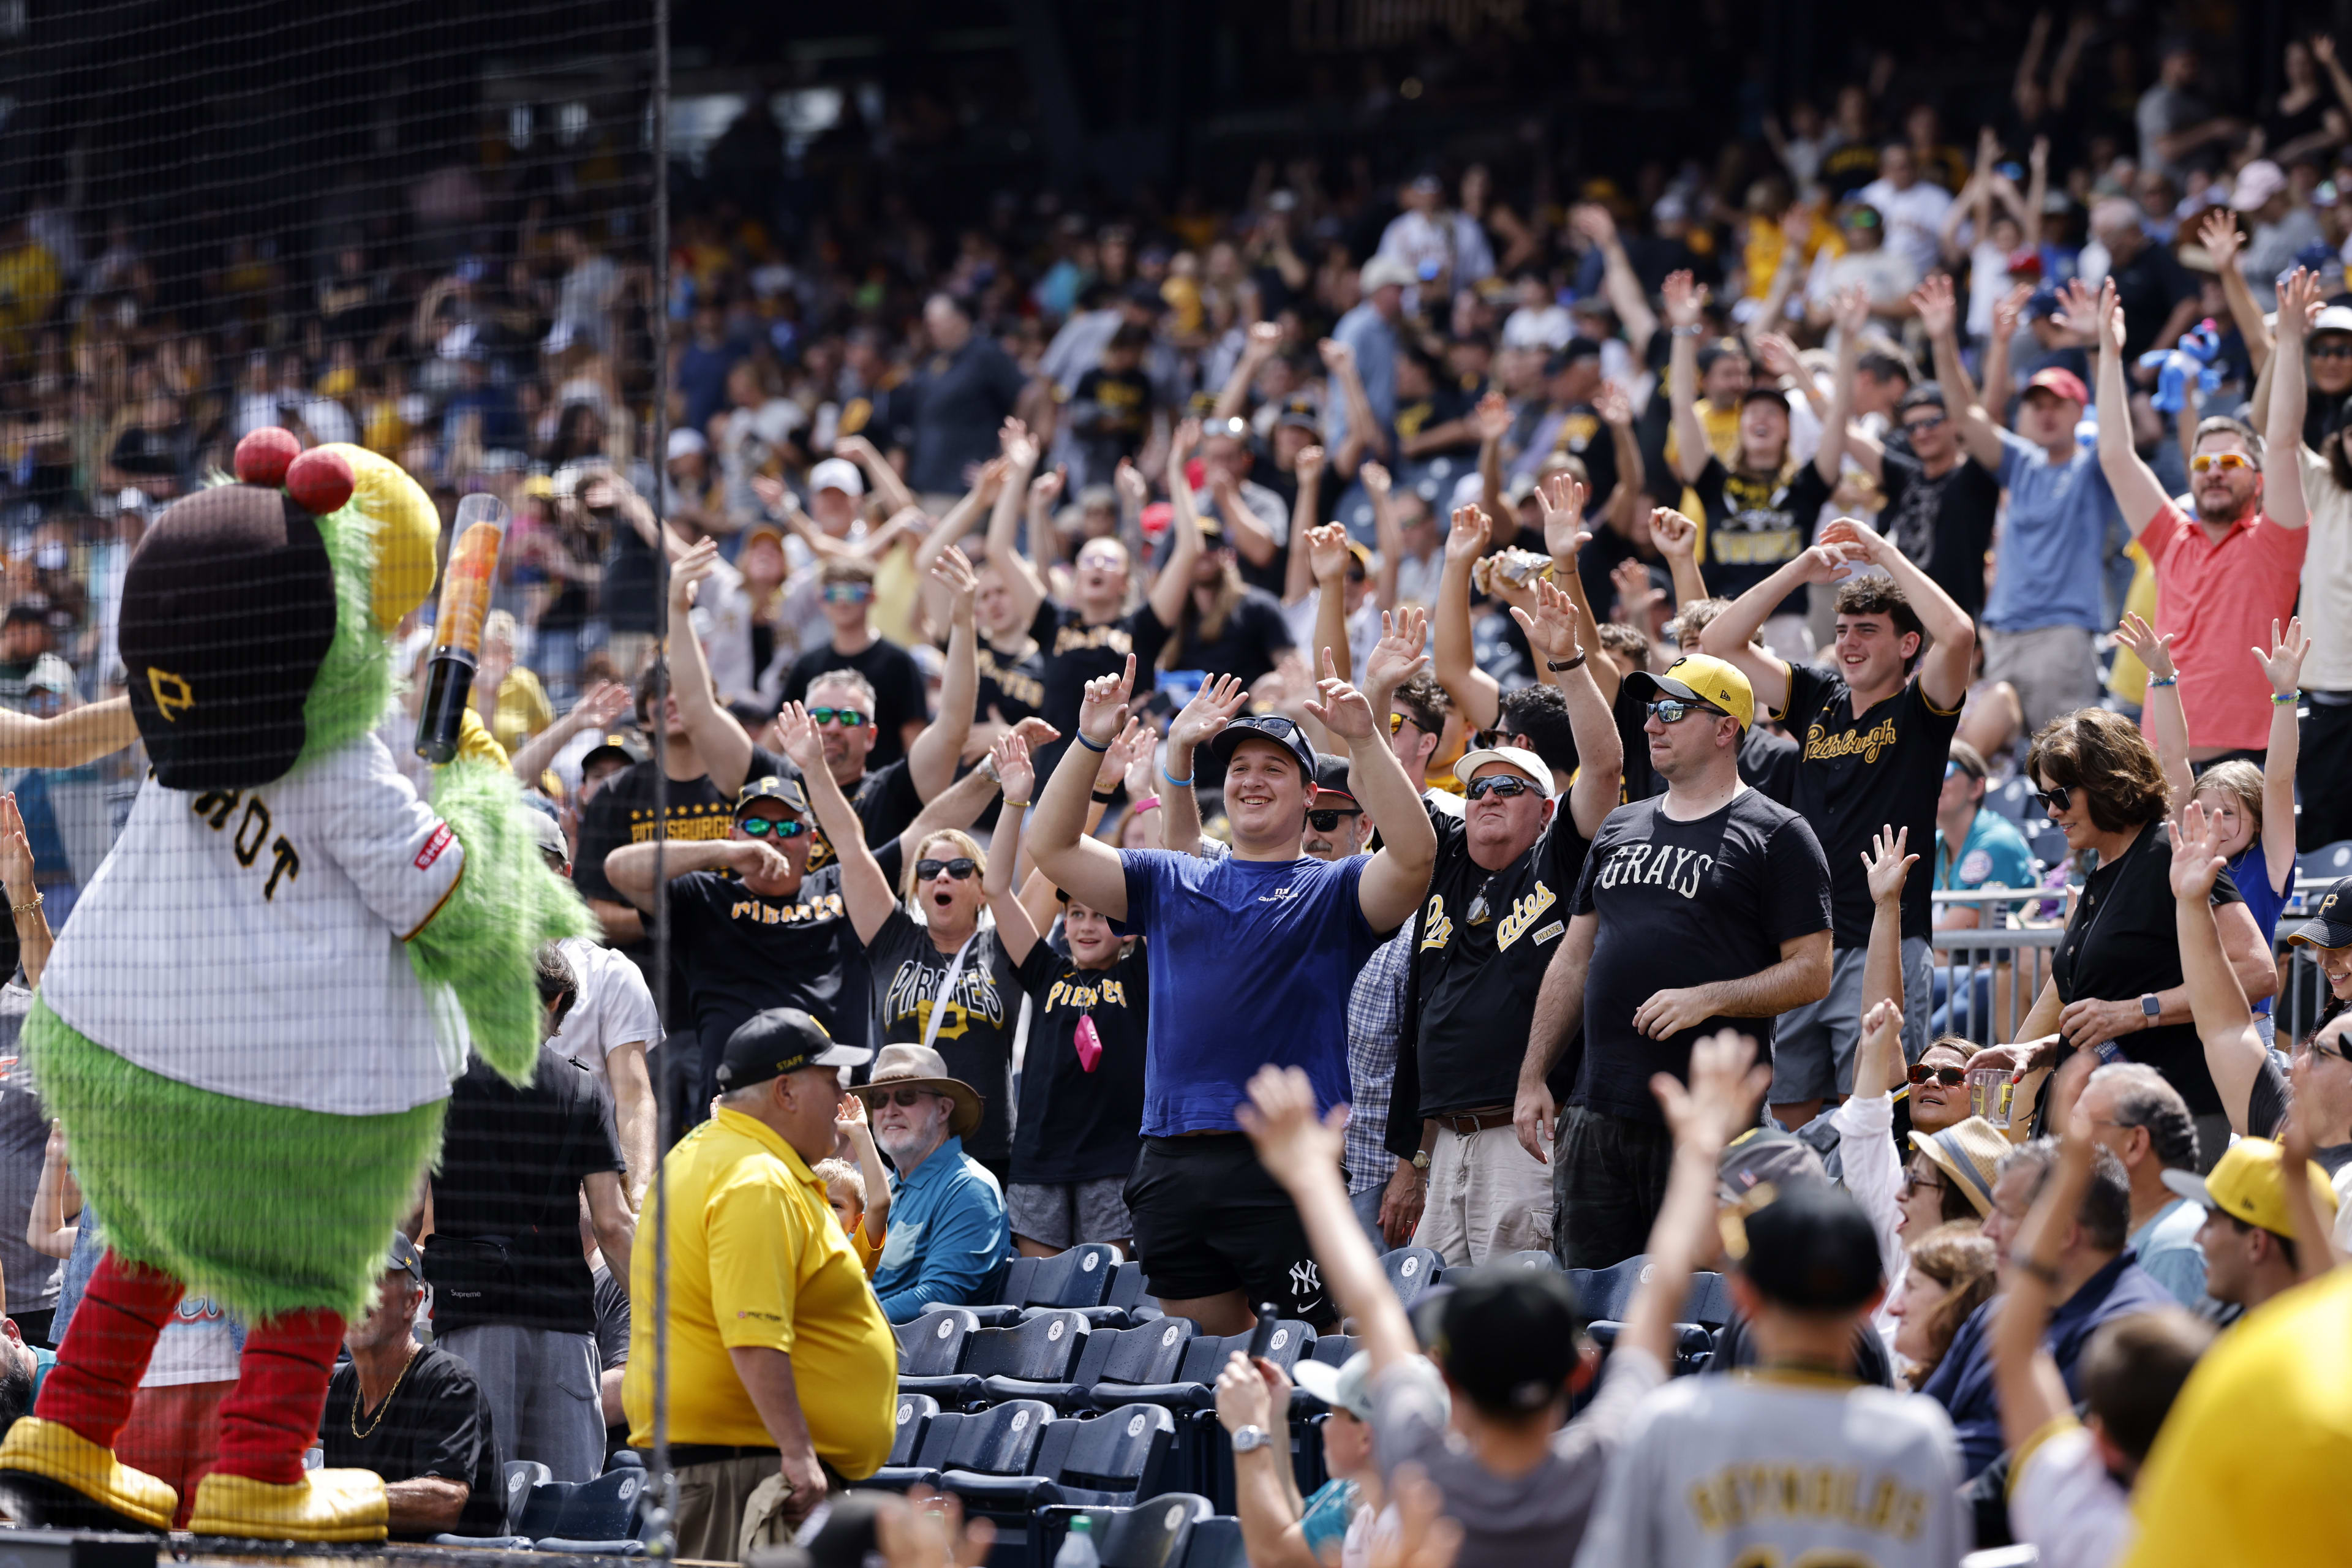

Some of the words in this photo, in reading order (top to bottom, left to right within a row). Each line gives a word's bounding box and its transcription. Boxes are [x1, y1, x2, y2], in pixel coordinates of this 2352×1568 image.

[760, 776, 780, 794] P
[631, 815, 734, 843] PITSBURGH
[1601, 845, 1714, 899] GRAYS
[2318, 894, 2339, 915] P
[1536, 924, 1562, 943] PIRATES
[1045, 978, 1128, 1013] PIRAES
[775, 1054, 804, 1071] STAFF
[1087, 1257, 1094, 1267] 5
[1406, 1261, 1413, 1272] 8
[1289, 1259, 1321, 1295] NY
[450, 1289, 481, 1298] Supreme
[1052, 1325, 1060, 1335] 8
[1166, 1331, 1174, 1341] 9
[1273, 1334, 1285, 1344] 10
[899, 1409, 910, 1420] 10
[1014, 1416, 1025, 1426] 11
[1131, 1419, 1142, 1431] 12
[512, 1476, 521, 1487] 10
[621, 1482, 632, 1493] 11
